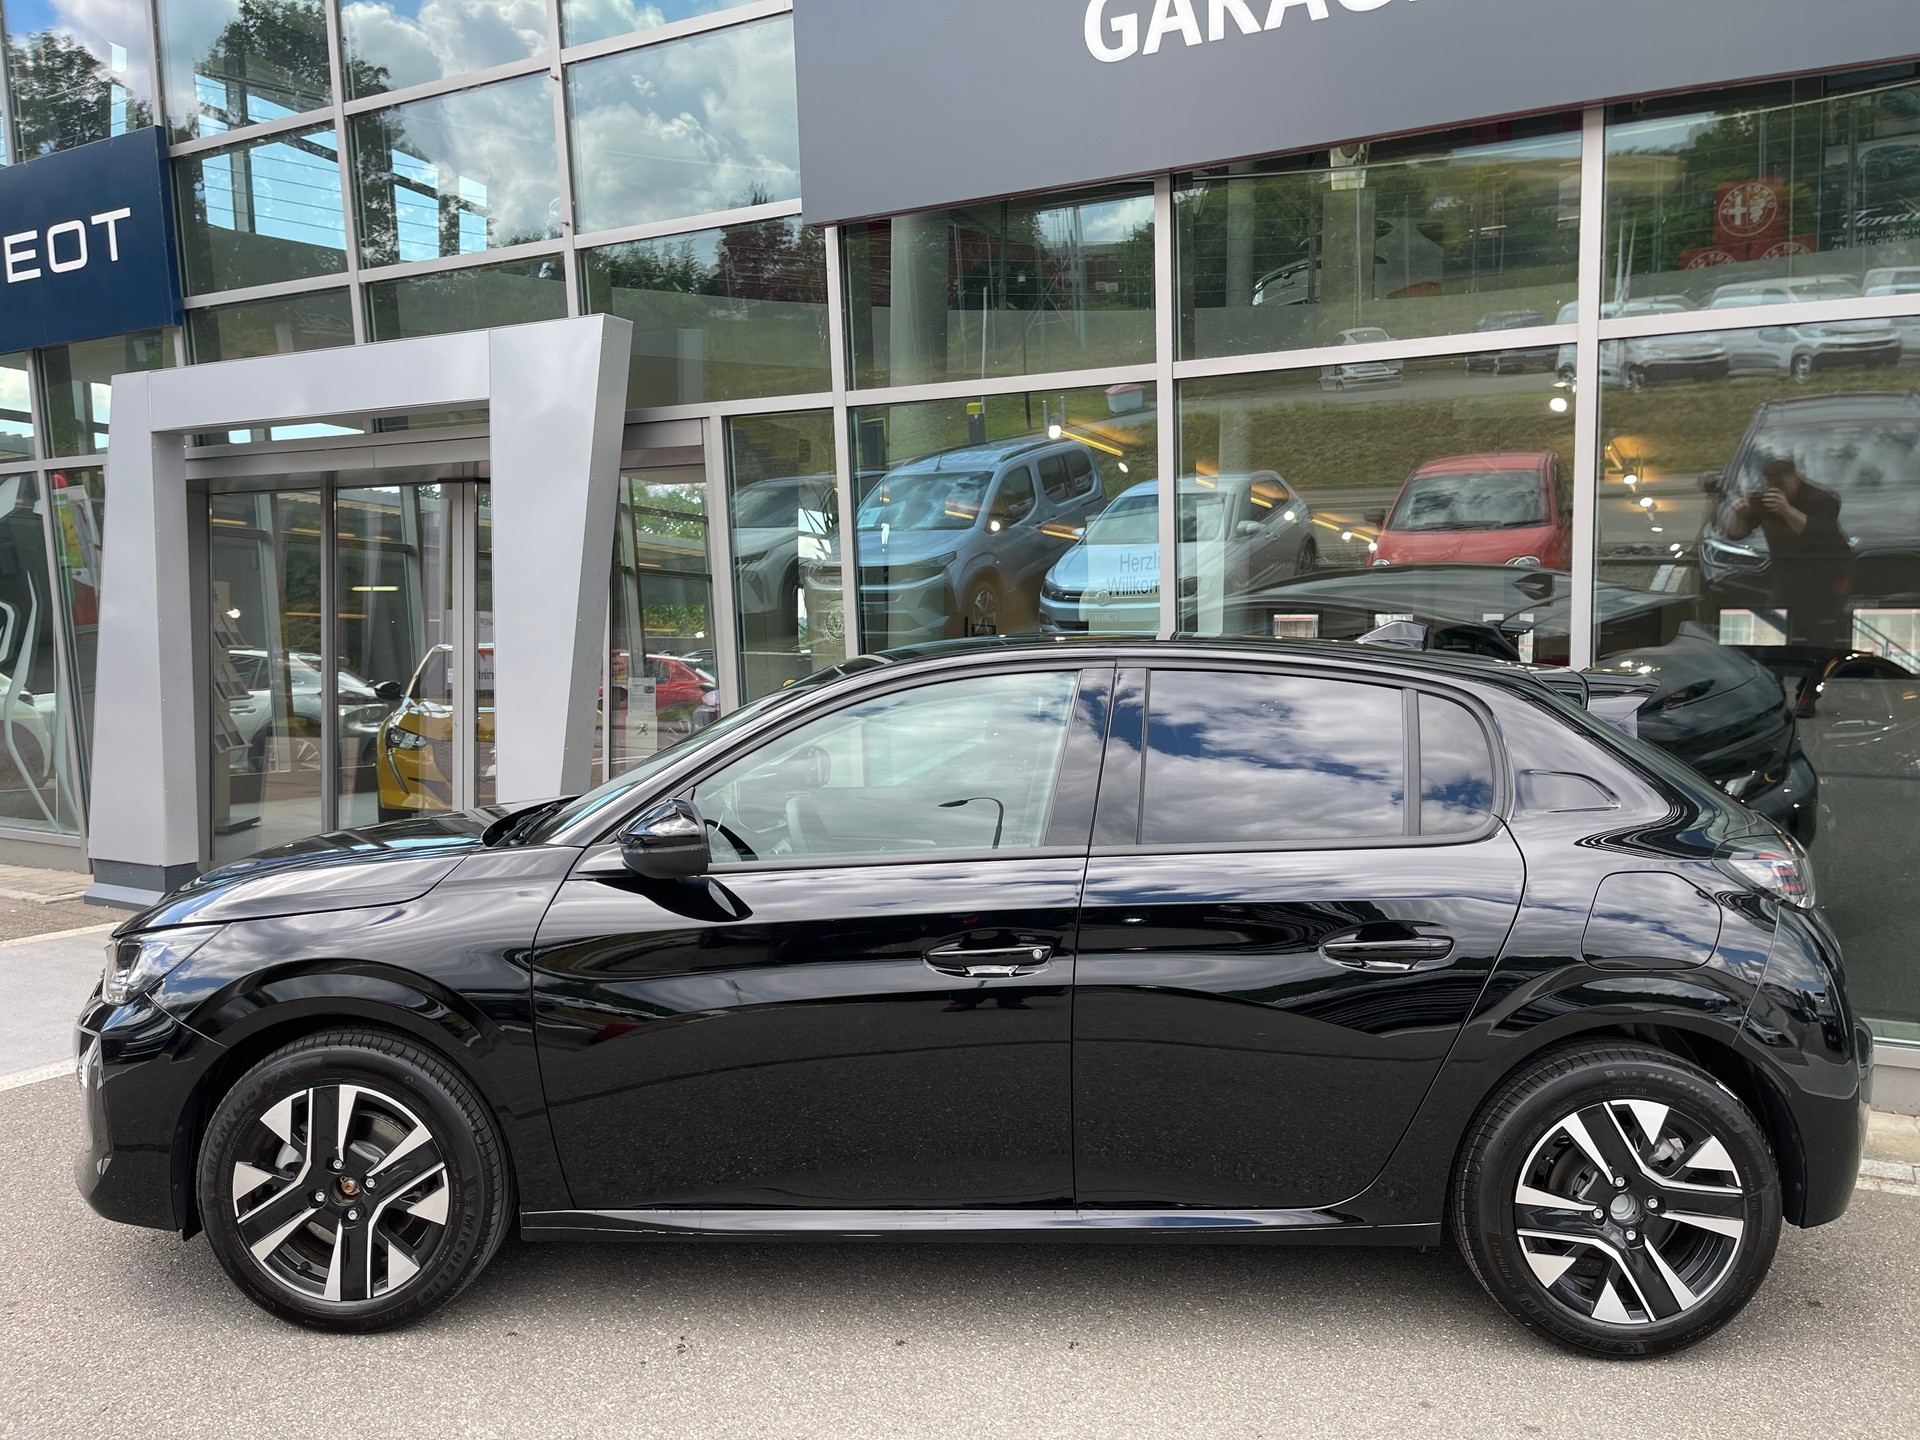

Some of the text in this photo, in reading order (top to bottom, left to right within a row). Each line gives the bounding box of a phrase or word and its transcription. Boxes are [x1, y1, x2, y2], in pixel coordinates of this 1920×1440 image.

[1721, 186, 1776, 215] ALFA ROMEO
[3, 206, 132, 284] EOT
[202, 1085, 259, 1174] MICHELIN
[419, 1214, 476, 1301] MICHELIN
